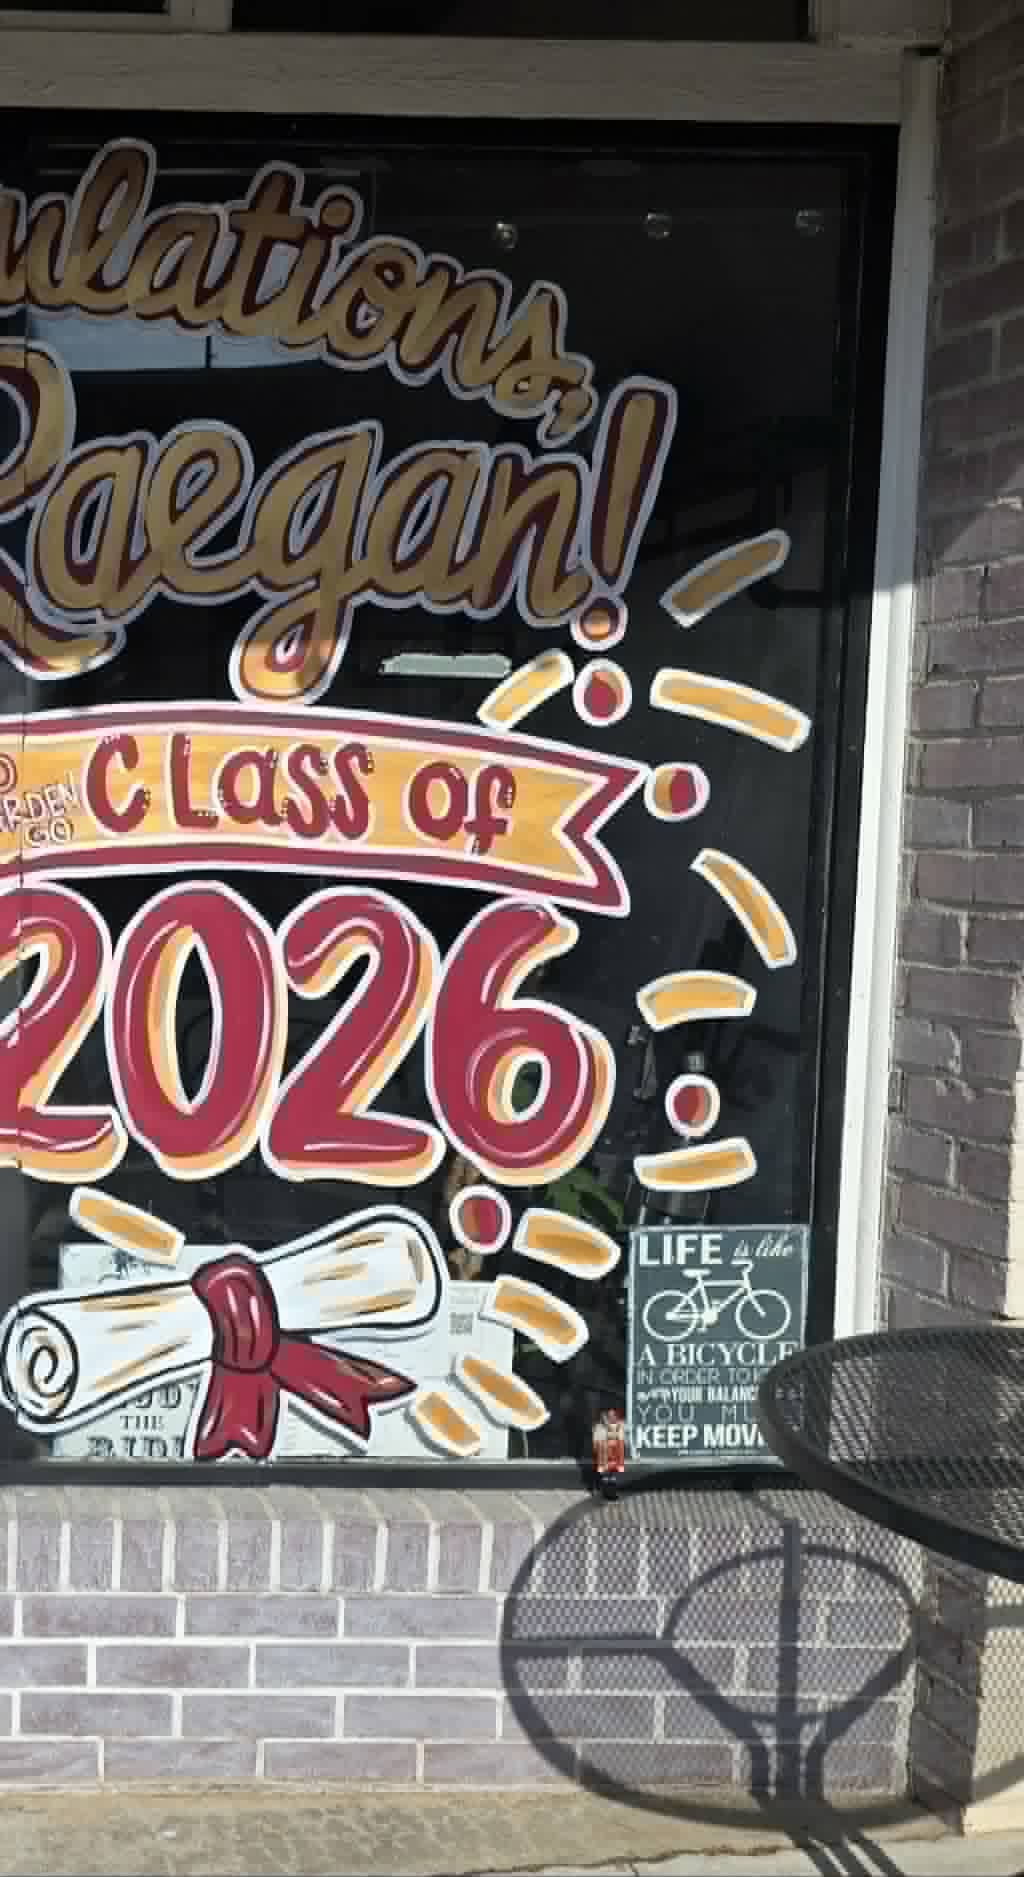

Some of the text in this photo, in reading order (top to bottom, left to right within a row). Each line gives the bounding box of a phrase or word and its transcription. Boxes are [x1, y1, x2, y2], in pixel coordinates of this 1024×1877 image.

[408, 760, 516, 857] of
[639, 1233, 723, 1265] LIFE
[639, 1343, 657, 1366] A
[637, 1367, 654, 1385] IN
[659, 1367, 720, 1385] ORDER
[728, 1367, 751, 1385] TO
[119, 1415, 165, 1431] THE
[637, 1405, 696, 1424] YOU
[636, 1424, 699, 1448] KEEP
